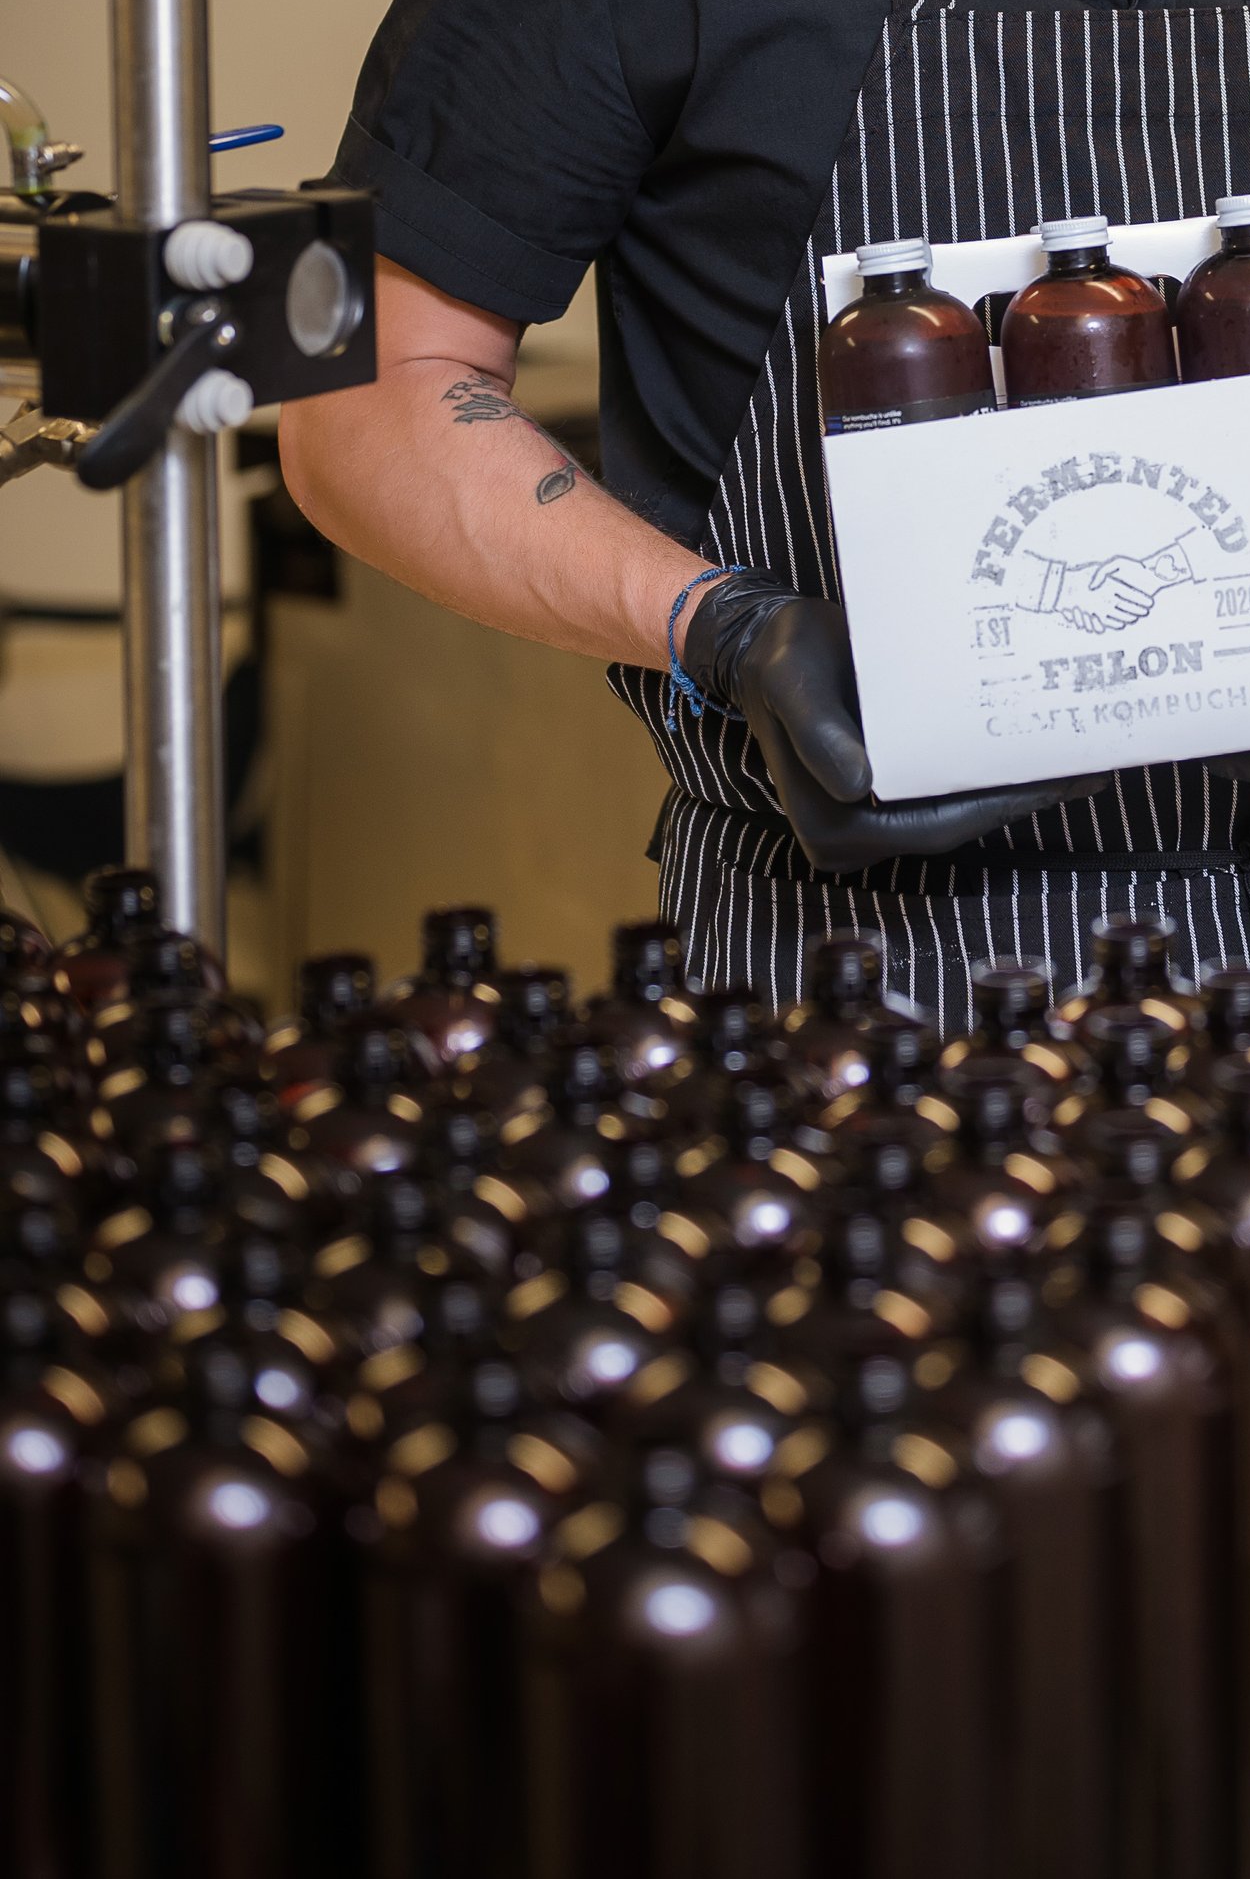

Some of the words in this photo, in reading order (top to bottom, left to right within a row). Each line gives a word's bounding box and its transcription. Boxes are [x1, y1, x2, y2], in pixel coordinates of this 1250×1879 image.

[971, 452, 1249, 586] FERMENTED
[1039, 640, 1204, 693] FELON
[986, 705, 1084, 737] CFT
